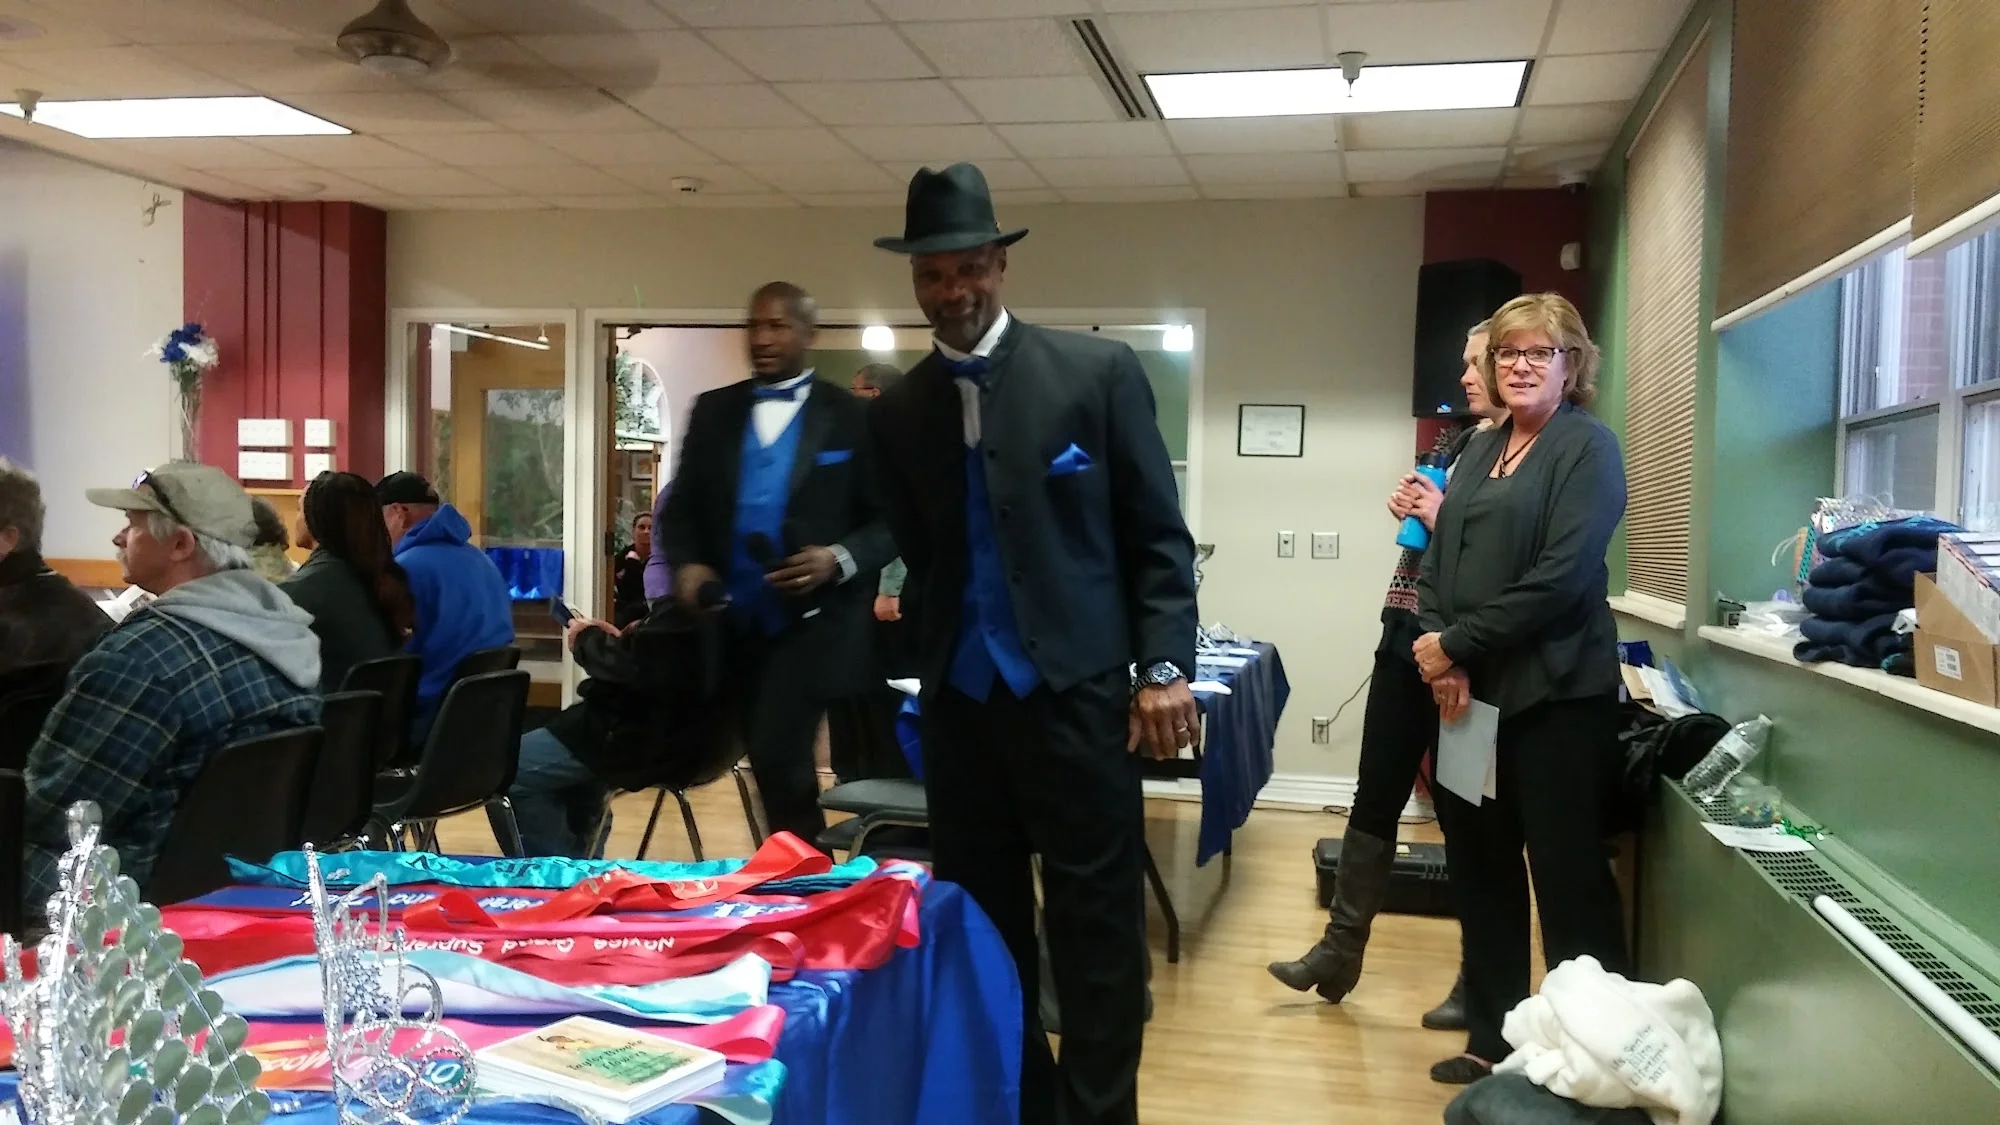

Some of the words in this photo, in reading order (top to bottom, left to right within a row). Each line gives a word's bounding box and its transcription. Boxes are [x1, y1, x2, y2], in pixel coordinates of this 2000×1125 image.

[501, 937, 575, 953] Grand
[593, 936, 675, 952] Novice
[566, 1055, 603, 1071] Taylor
[603, 1039, 644, 1057] Brooke
[602, 1050, 647, 1070] Flowers
